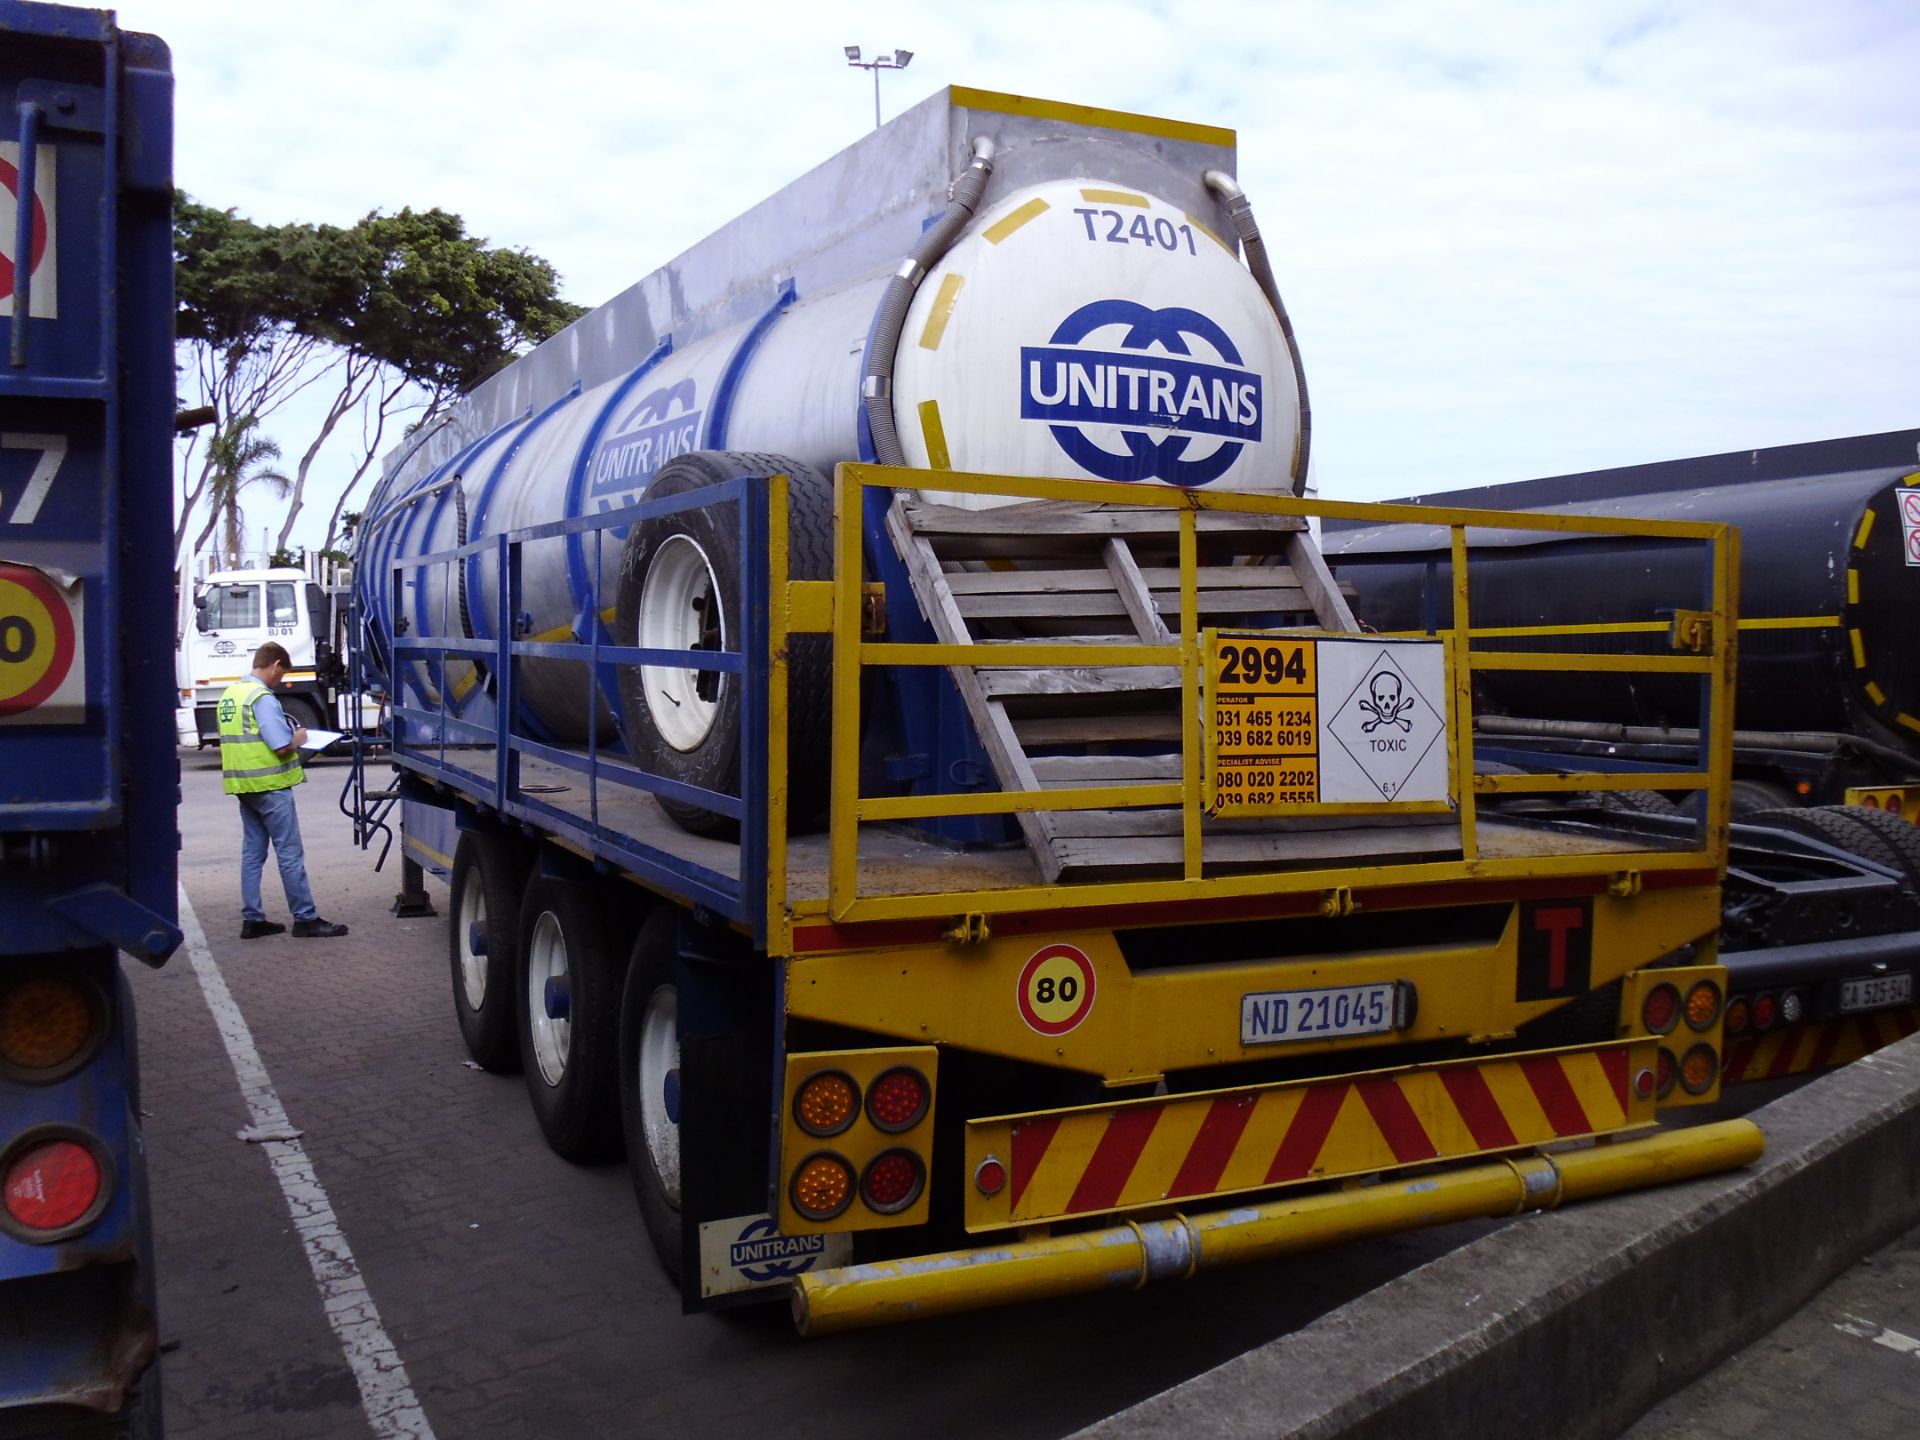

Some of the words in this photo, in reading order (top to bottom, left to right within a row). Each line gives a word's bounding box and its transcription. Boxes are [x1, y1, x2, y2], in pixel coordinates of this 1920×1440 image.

[1074, 208, 1197, 256] T2401
[1030, 361, 1258, 426] UNITRANS
[597, 424, 695, 485] UNITRANS
[0, 434, 68, 524] 7
[281, 628, 293, 636] 01
[1219, 646, 1307, 685] 2994
[1216, 710, 1240, 726] 031
[1246, 710, 1272, 726] 465
[1277, 711, 1312, 726] 1234
[1217, 730, 1242, 746] 039
[1246, 730, 1273, 746] 682
[1277, 730, 1311, 746] 6019
[1369, 739, 1407, 752] TOXIC
[1217, 758, 1252, 766] PECIALIST
[1254, 758, 1280, 766] ADVISE
[1217, 772, 1243, 788] 080
[1247, 772, 1274, 787] 020
[1279, 771, 1314, 787] 2202
[1382, 782, 1397, 793] 6.1
[1216, 793, 1243, 808] 039
[1247, 792, 1274, 804] 682
[1280, 791, 1315, 803] 5555
[1534, 907, 1582, 989] T
[1035, 977, 1078, 1003] 80
[1843, 985, 1858, 1008] CA
[1251, 999, 1289, 1036] ND
[1297, 990, 1384, 1032] 21045
[732, 1235, 822, 1263] UNITRANS
